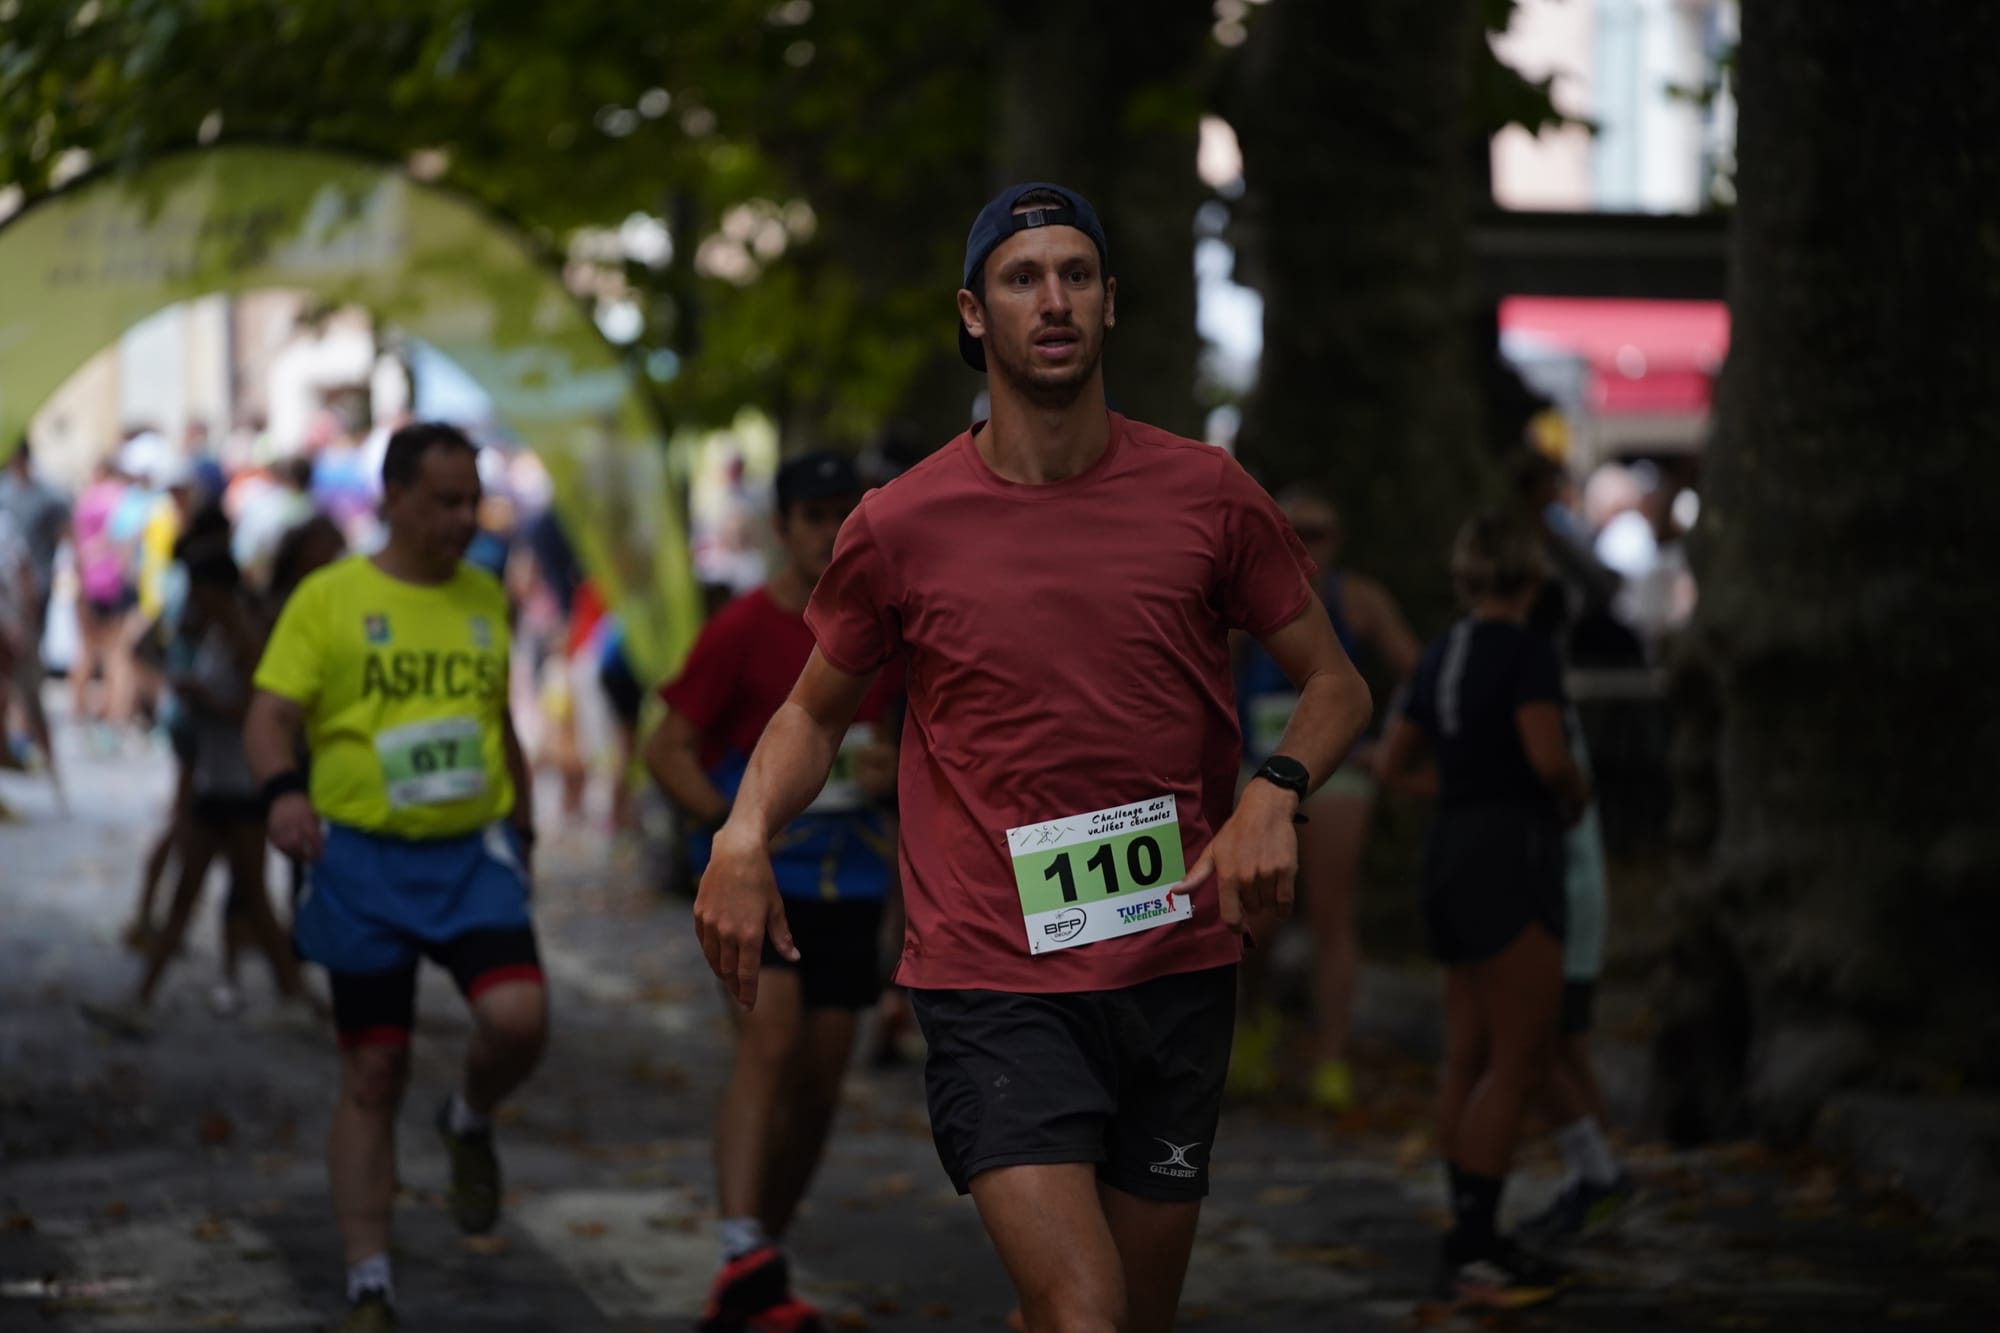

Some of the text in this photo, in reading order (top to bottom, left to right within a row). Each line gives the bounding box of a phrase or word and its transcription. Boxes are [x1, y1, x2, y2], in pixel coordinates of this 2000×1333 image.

[361, 651, 505, 702] ASICS
[1092, 801, 1164, 824] Challenge des
[1088, 821, 1124, 835] vallées
[1044, 835, 1162, 902] 110
[1117, 899, 1162, 918] TUFF'S
[1123, 906, 1168, 924] Aventure
[1044, 918, 1081, 935] BFP
